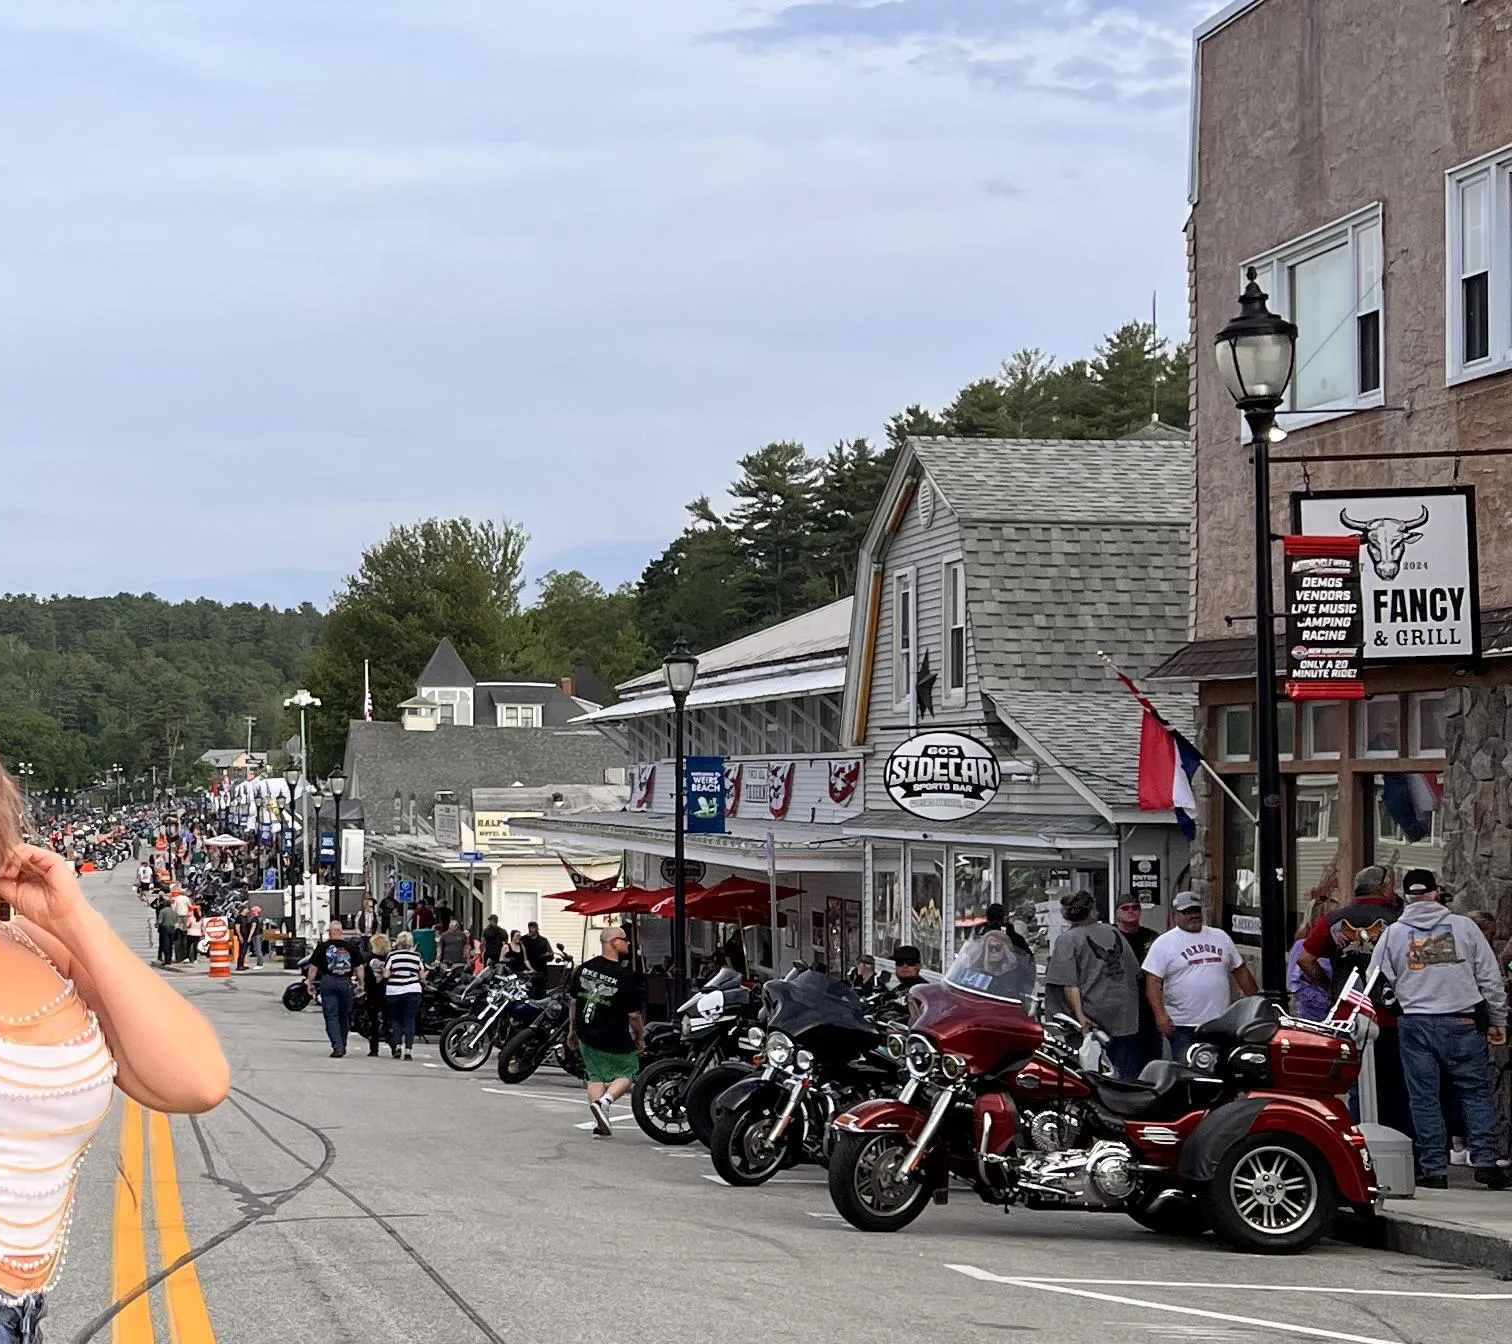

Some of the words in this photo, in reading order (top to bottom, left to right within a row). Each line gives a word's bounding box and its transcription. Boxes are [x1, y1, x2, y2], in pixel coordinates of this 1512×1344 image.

[1403, 561, 1429, 570] 2024
[1302, 577, 1343, 588] DEMOS
[1296, 590, 1351, 601] VENDORS
[1291, 604, 1317, 614] LIVE
[1318, 603, 1357, 614] MUSIC
[1373, 587, 1465, 623] FANCY
[1302, 630, 1347, 641] RACING
[1373, 630, 1388, 647] &
[1396, 628, 1461, 646] GRILL
[1300, 660, 1326, 669] ONLY
[1326, 660, 1334, 669] A
[1335, 660, 1349, 669] 20
[1292, 669, 1330, 678] MINUTE
[927, 747, 959, 755] 603
[889, 757, 996, 788] SIDECAR
[693, 776, 719, 784] WEIRS
[692, 784, 721, 792] BEACH
[912, 783, 950, 791] SPORTS
[953, 783, 973, 792] BAR
